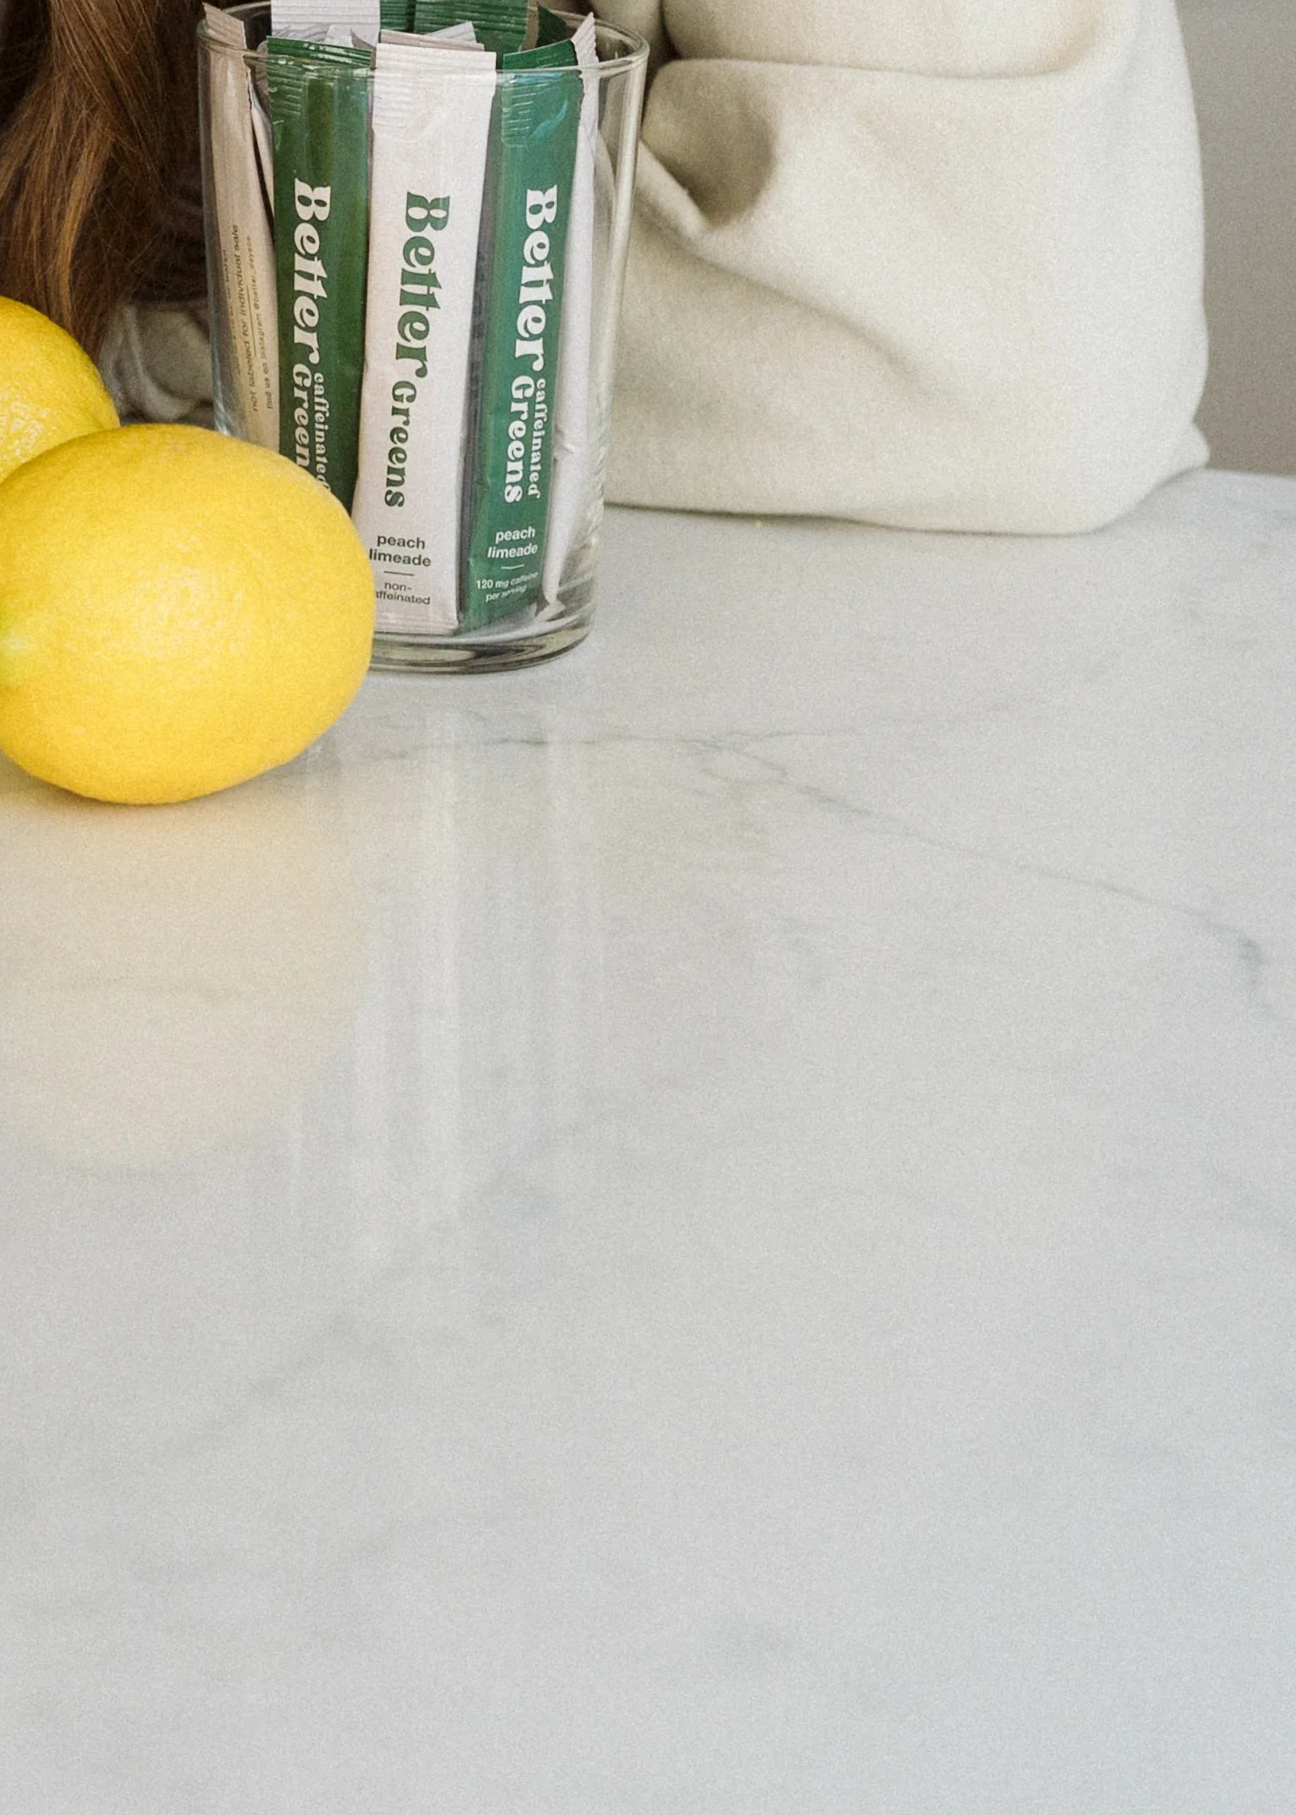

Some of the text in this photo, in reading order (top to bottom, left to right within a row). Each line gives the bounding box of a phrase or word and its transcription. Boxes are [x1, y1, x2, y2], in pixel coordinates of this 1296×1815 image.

[231, 224, 240, 252] sale
[240, 318, 249, 337] for
[292, 177, 331, 467] Better Green
[384, 190, 451, 508] Better Greens
[504, 184, 558, 504] Better Greens
[248, 391, 259, 412] not
[527, 377, 548, 499] caffeinated
[376, 535, 426, 550] peach
[495, 526, 536, 544] peach
[369, 548, 432, 568] limeade
[487, 543, 539, 559] limeade
[383, 581, 412, 591] non-
[476, 579, 494, 590] 120
[375, 590, 431, 605] affeinated
